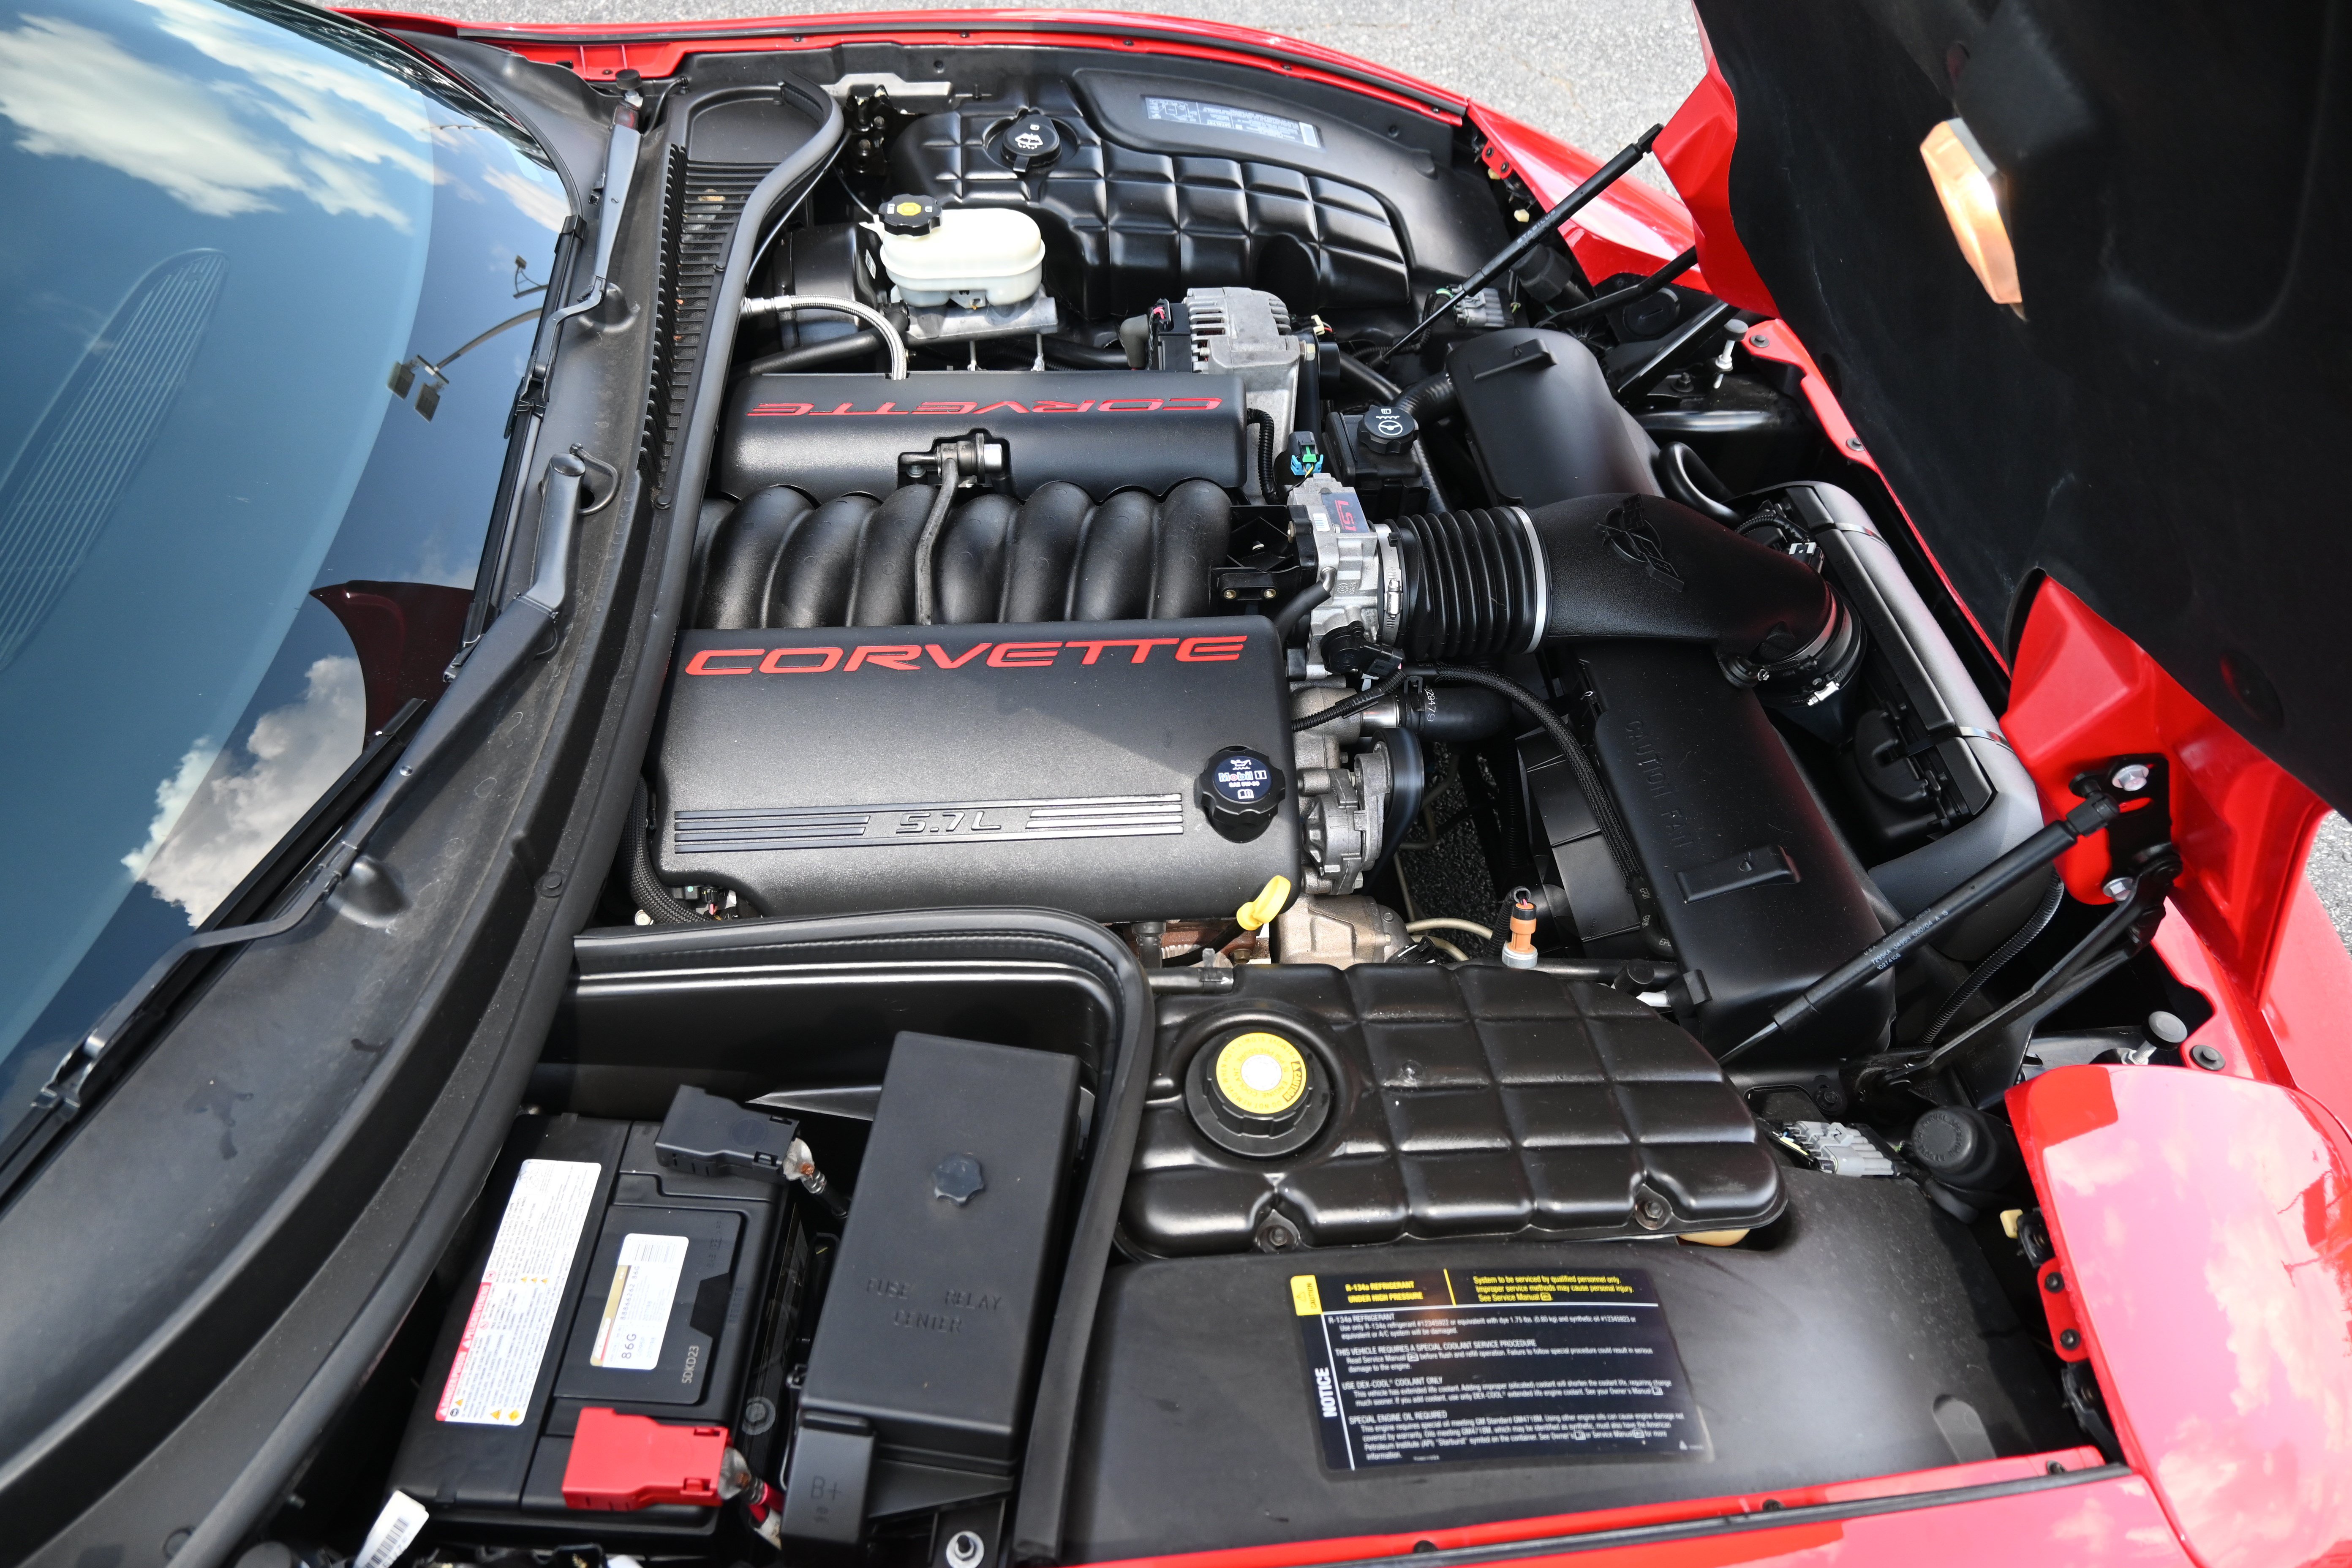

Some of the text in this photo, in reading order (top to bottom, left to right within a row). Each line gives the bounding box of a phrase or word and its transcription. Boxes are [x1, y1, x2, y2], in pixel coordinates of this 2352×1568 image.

[747, 397, 1222, 416] CORVETTE
[685, 635, 1247, 675] CORVETTE
[1626, 720, 1672, 799] CAUTION
[1218, 771, 1254, 782] Mobil
[896, 810, 1002, 833] 5.7L
[1870, 948, 1892, 965] 7295KA
[1346, 1281, 1413, 1291] R-134a REFRIGERANT
[1473, 1276, 1497, 1285] System
[1542, 1276, 1549, 1284] by
[1551, 1275, 1576, 1284] qualified
[1306, 1282, 1318, 1309] CAUTION
[1476, 1285, 1504, 1294] Improper
[1557, 1285, 1569, 1293] may
[1590, 1285, 1614, 1293] personal
[945, 1288, 1002, 1311] RELAY
[1348, 1292, 1423, 1303] UNDER HIGH PRESSURE
[1478, 1293, 1539, 1301] See Service Manual
[894, 1309, 963, 1333] CENTER
[1328, 1313, 1394, 1324] R-134a REFRIGERANT
[1339, 1323, 1350, 1331] Use
[1352, 1323, 1363, 1331] only
[1364, 1321, 1386, 1330] R-134a
[1387, 1320, 1416, 1329] refrigerant
[1457, 1318, 1485, 1326] equivalent
[1499, 1317, 1508, 1325] dye
[1341, 1331, 1370, 1340] equivalent
[621, 1334, 637, 1359] 86G
[1335, 1348, 1350, 1356] THIS
[1351, 1347, 1376, 1355] VEHICLE
[1378, 1345, 1409, 1353] REQUIRES
[1416, 1343, 1442, 1351] SPECIAL
[1443, 1342, 1471, 1350] COOLANT
[1473, 1340, 1499, 1349] SERVICE
[1500, 1339, 1536, 1348] PROCEDURE
[1346, 1356, 1361, 1364] Read
[1385, 1353, 1405, 1361] Manual
[1348, 1365, 1371, 1373] damage
[1342, 1381, 1355, 1390] USE
[1394, 1377, 1424, 1386] COOLANT
[1426, 1376, 1442, 1384] ONLY
[1315, 1367, 1338, 1418] NOTICE
[1349, 1410, 1446, 1424] SPECIAL ENGINE OIL REQUIRED
[811, 1475, 842, 1500] B+
